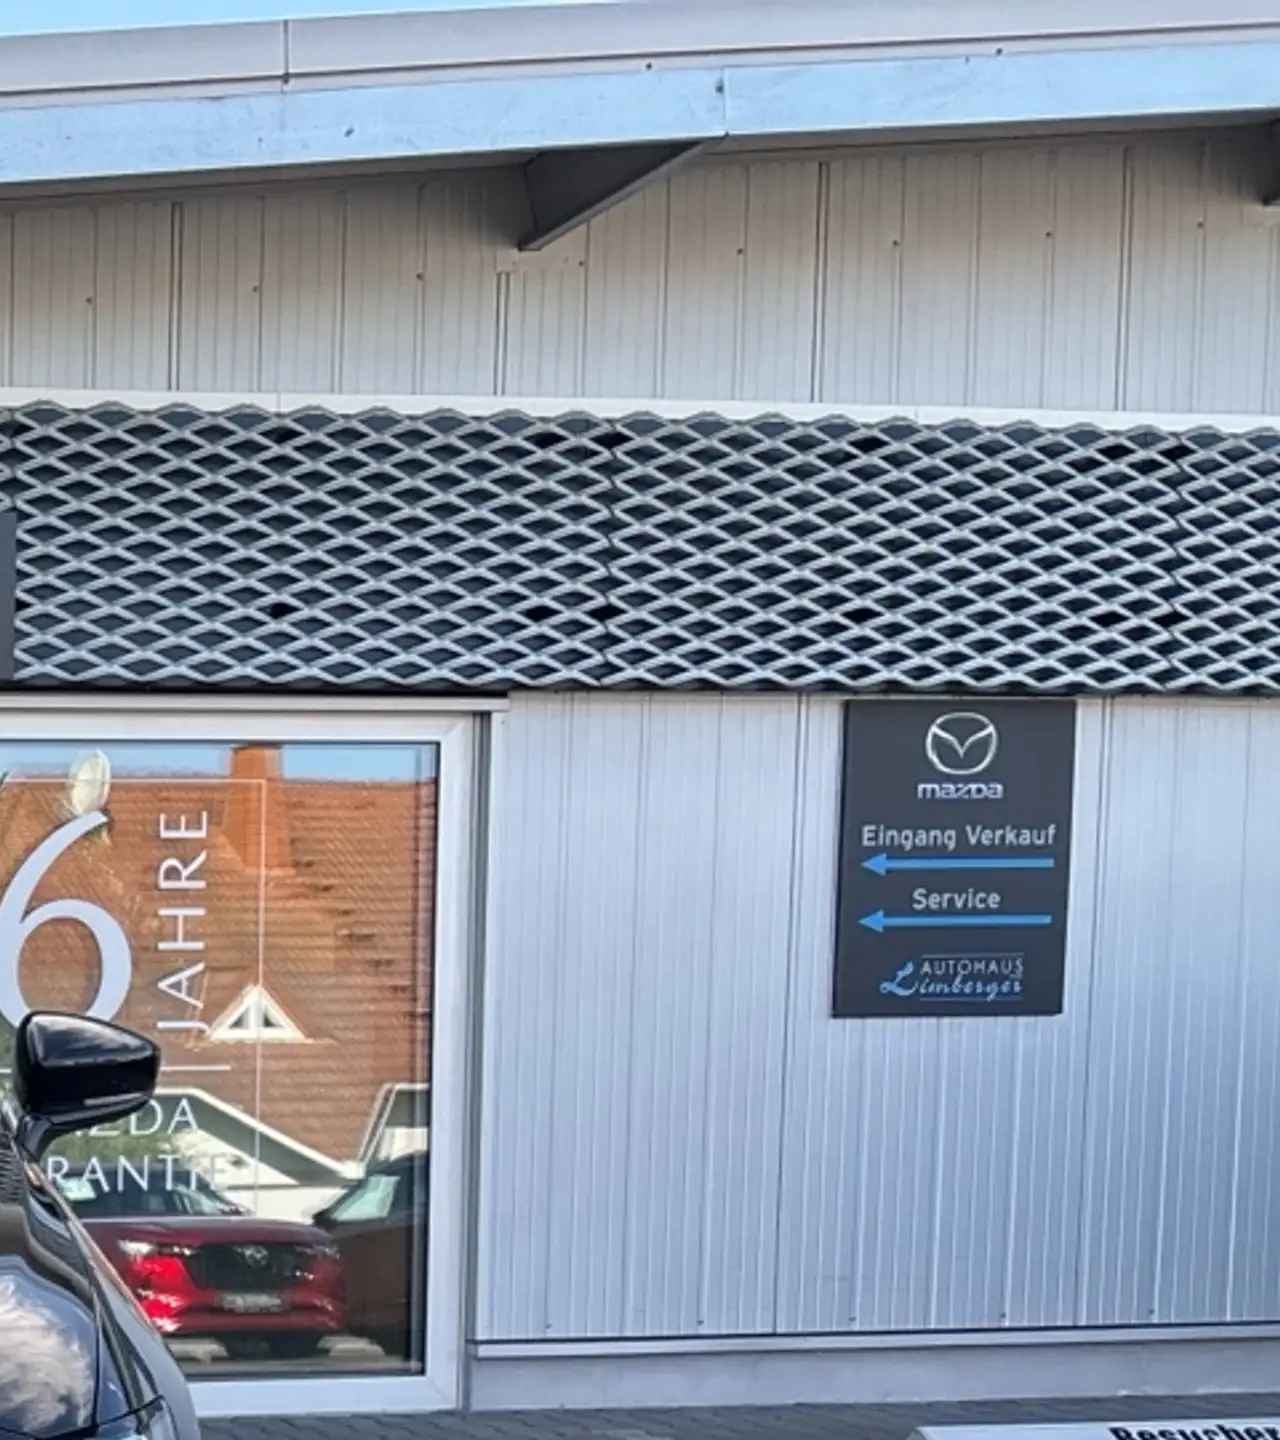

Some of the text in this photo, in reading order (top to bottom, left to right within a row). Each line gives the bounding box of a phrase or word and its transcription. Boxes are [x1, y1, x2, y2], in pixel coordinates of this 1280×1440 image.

[917, 783, 1004, 799] mazda
[861, 824, 1057, 852] Eingang Verkauf
[912, 888, 1001, 910] Service
[156, 810, 211, 1040] JAHRE
[920, 958, 1023, 975] AUTOHAUS
[879, 961, 1021, 1001] Limberger
[46, 1153, 229, 1193] RANTIE
